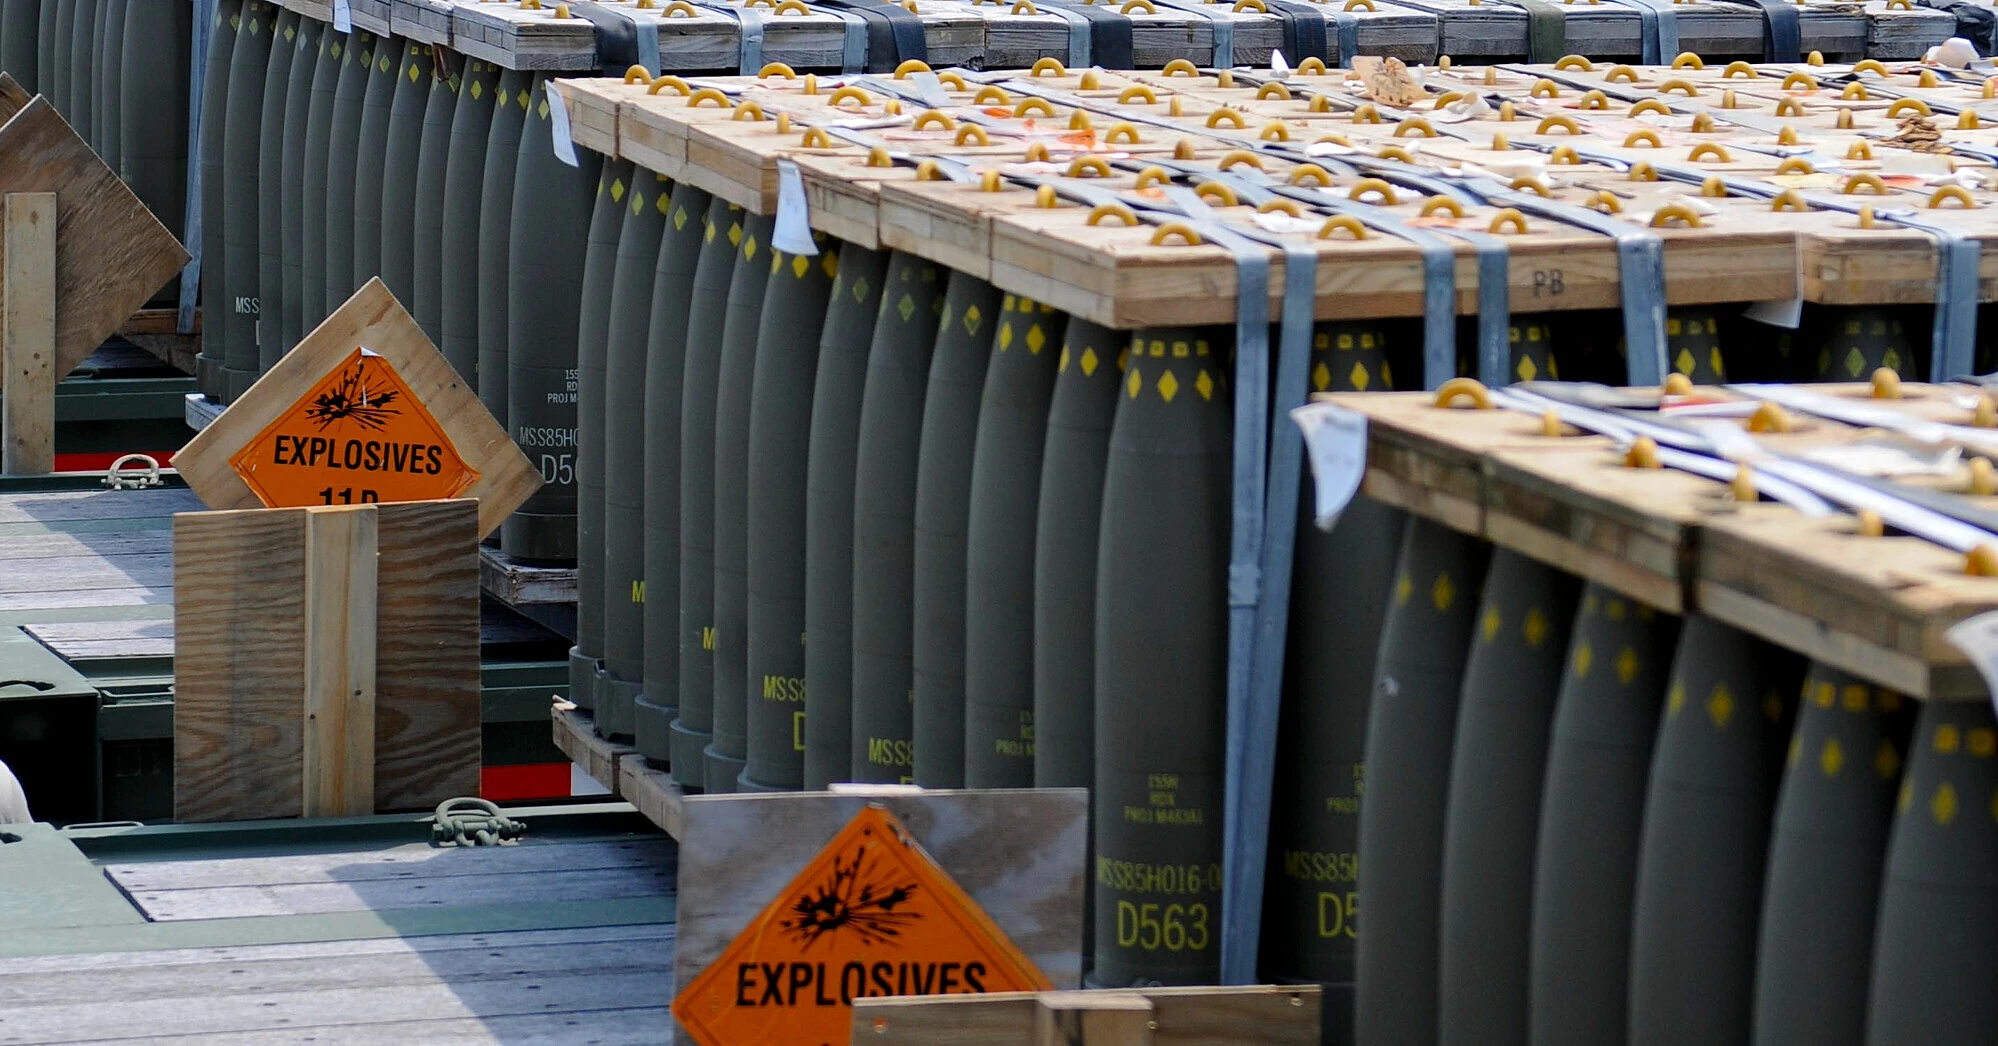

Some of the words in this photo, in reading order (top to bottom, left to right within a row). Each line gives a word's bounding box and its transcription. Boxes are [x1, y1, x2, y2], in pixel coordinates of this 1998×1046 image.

[1533, 268, 1564, 297] PB
[235, 296, 260, 314] MSS
[547, 393, 568, 403] PROJ
[274, 435, 442, 475] EXPLOSIVES
[541, 454, 579, 484] D5
[632, 580, 645, 602] M
[1117, 900, 1209, 951] D563
[736, 961, 987, 1007] EXPLOSIVES
